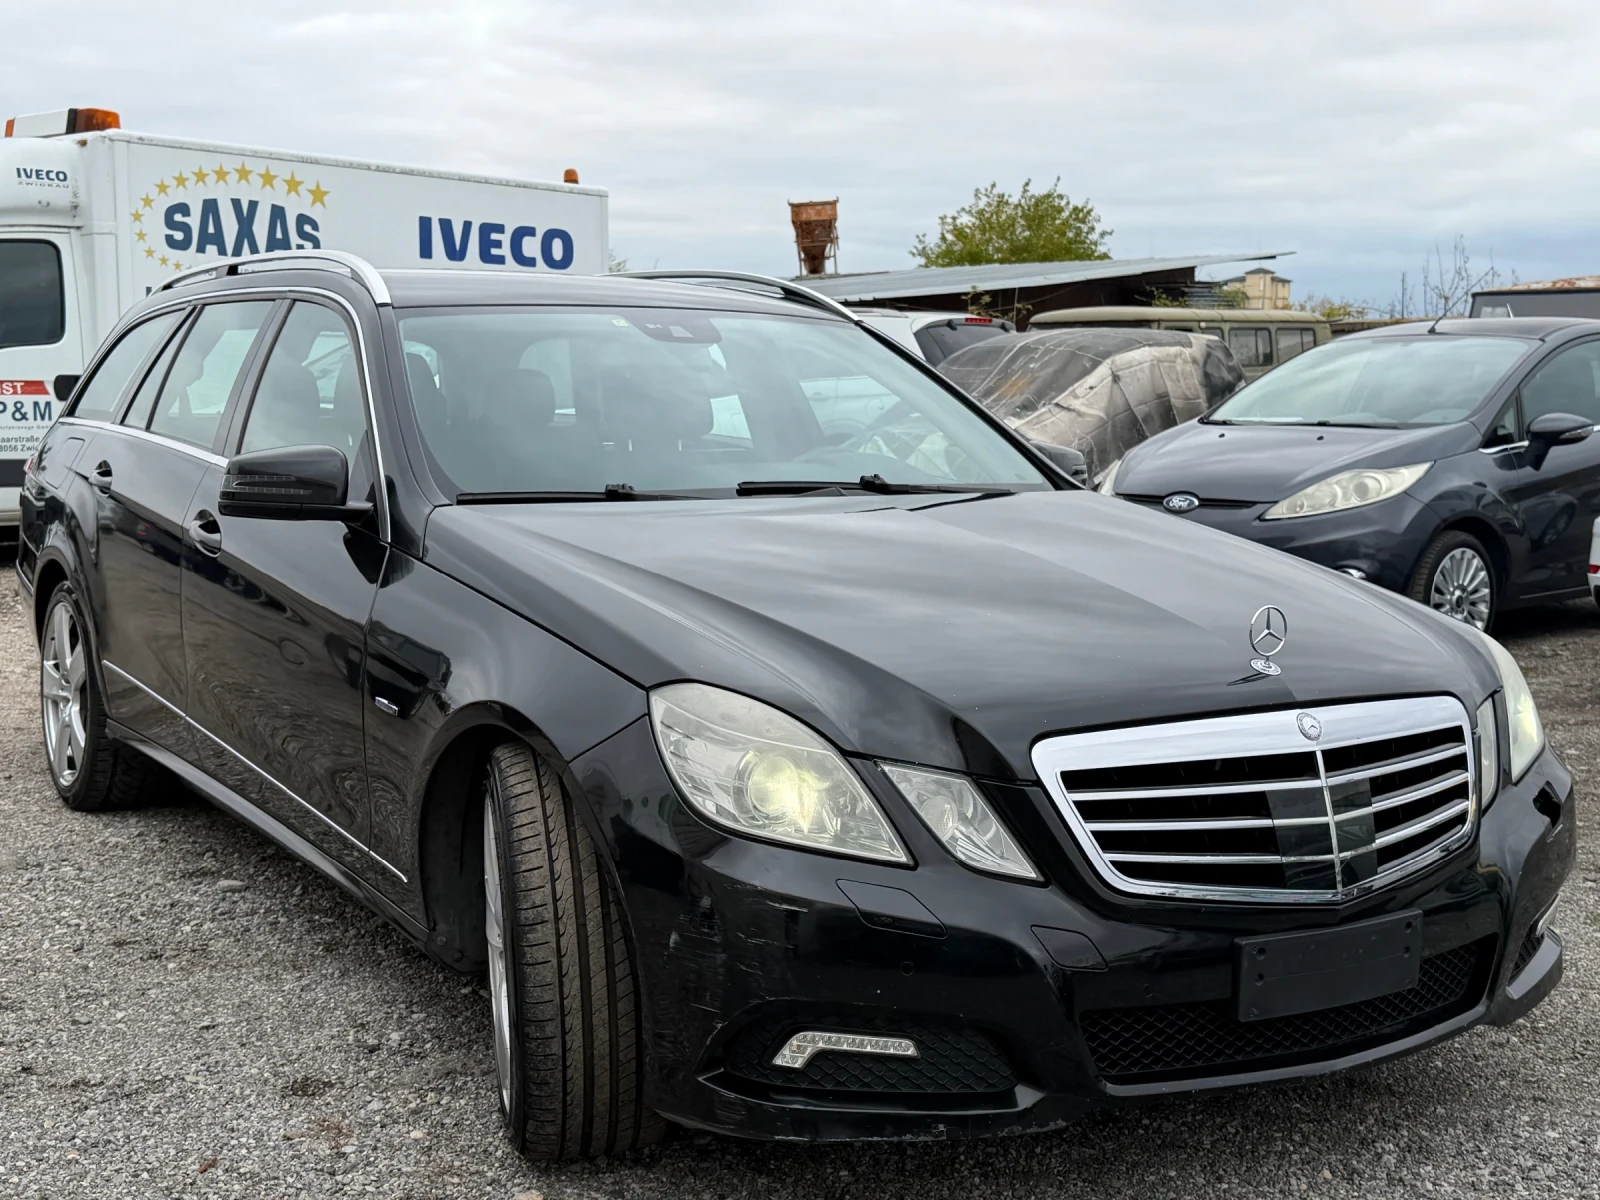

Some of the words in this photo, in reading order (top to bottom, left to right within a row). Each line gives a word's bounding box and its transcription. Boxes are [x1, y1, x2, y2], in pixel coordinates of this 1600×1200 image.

[16, 167, 68, 182] IVECO
[164, 198, 321, 257] SAXAS
[418, 215, 574, 271] IVECO
[0, 382, 24, 394] ST
[1169, 498, 1190, 509] Ford
